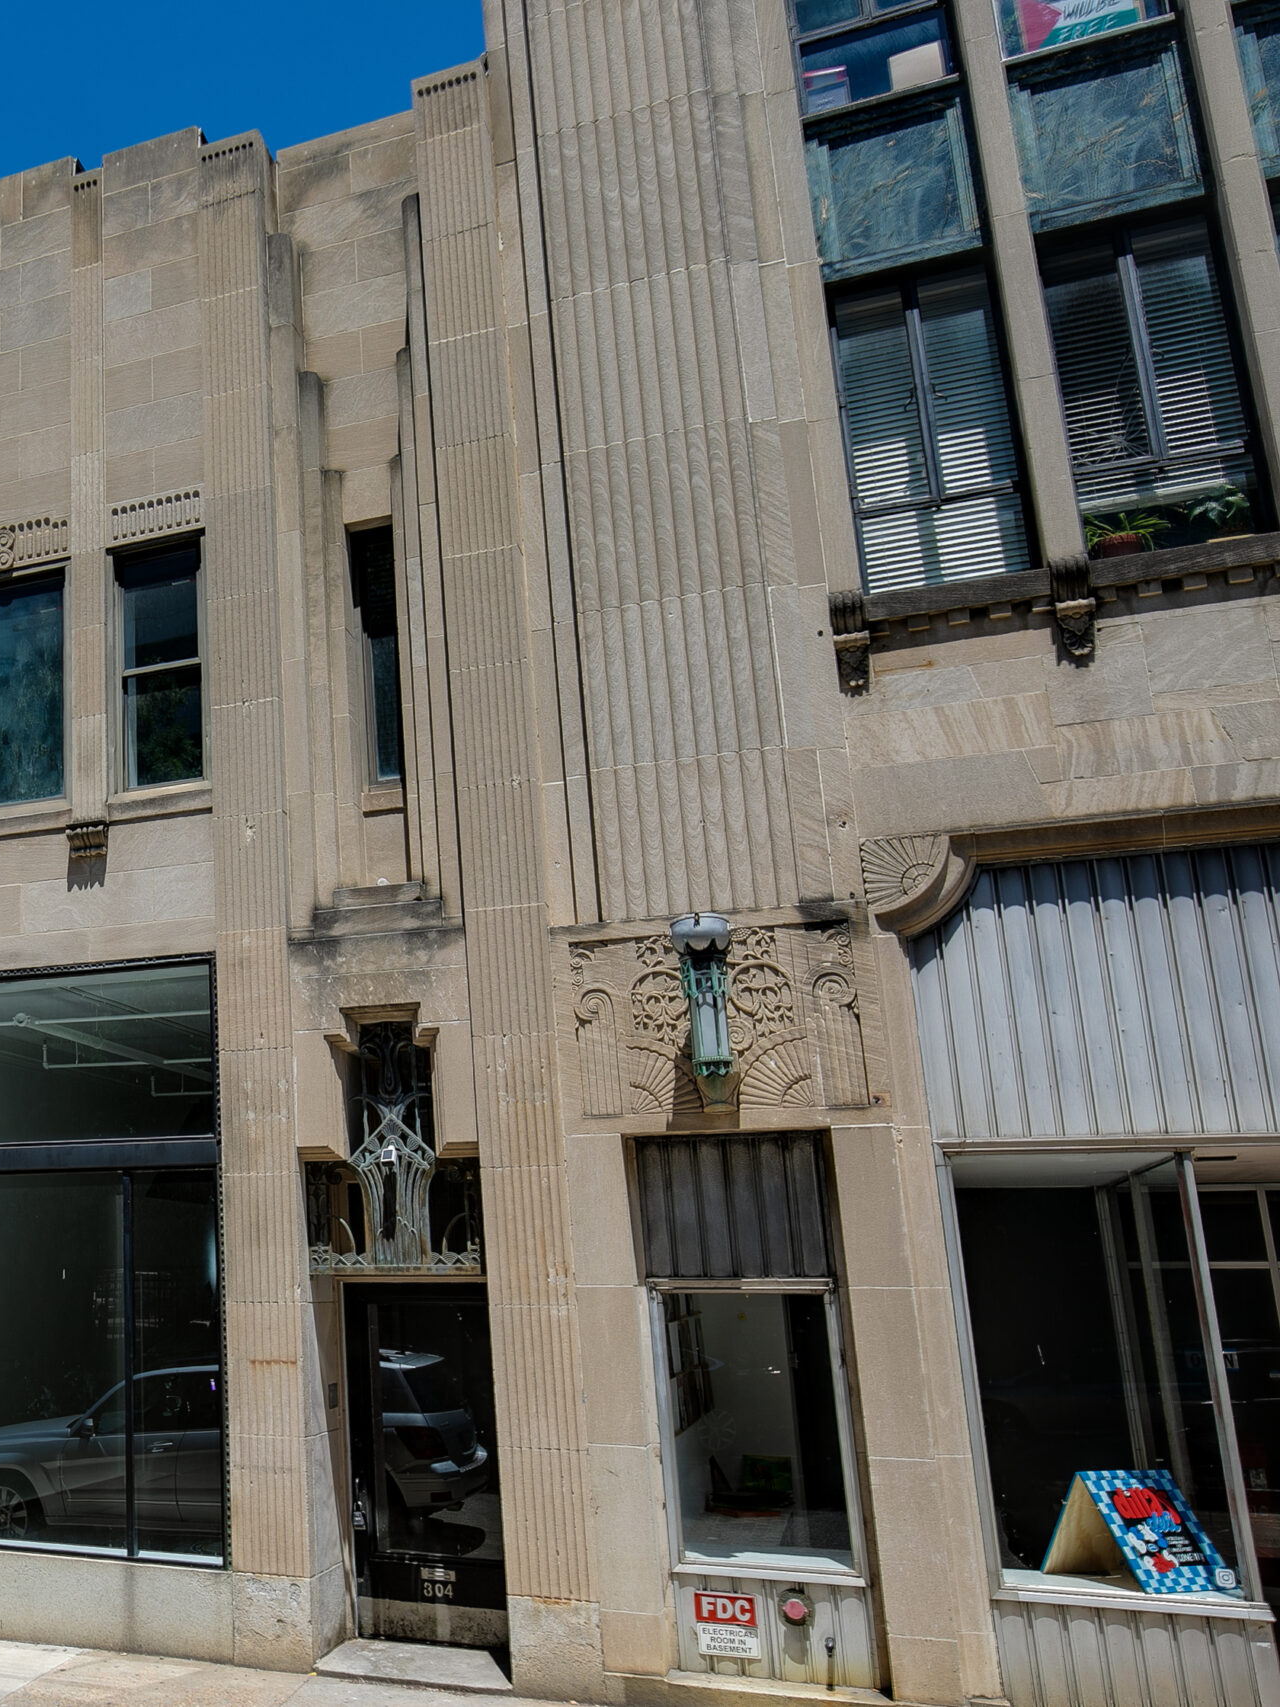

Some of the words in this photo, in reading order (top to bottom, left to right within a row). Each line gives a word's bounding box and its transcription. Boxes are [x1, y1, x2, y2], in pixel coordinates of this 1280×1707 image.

[1055, 13, 1119, 43] FREE
[423, 1581, 454, 1599] 304
[701, 1596, 752, 1622] FDC
[702, 1627, 755, 1639] ELECTRICAL
[706, 1643, 752, 1654] BASEMENT
[710, 1636, 735, 1645] ROOM
[738, 1638, 747, 1646] IN
